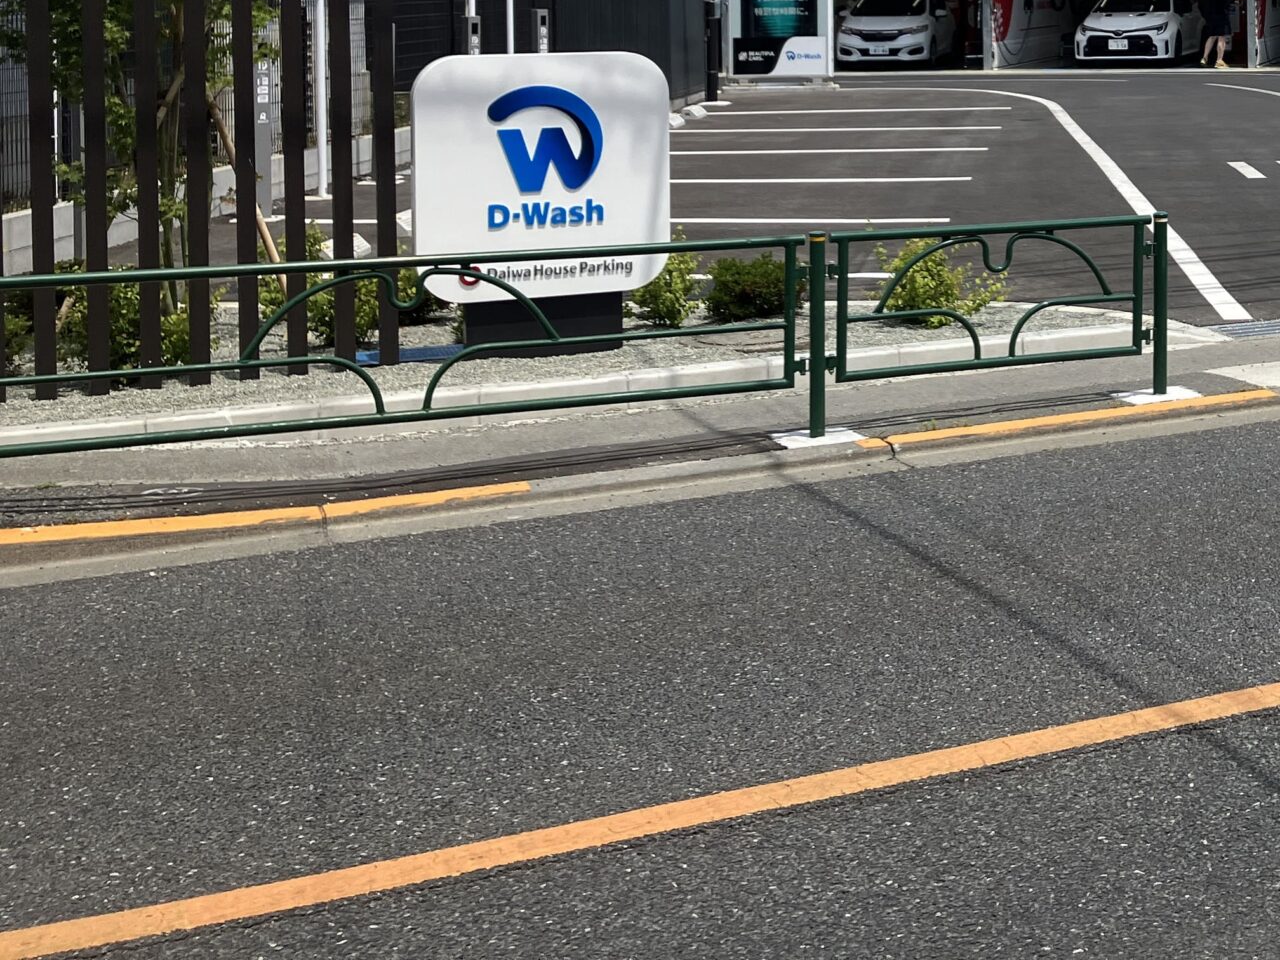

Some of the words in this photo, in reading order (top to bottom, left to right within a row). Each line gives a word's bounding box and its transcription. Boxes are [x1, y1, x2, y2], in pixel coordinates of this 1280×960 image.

[487, 198, 604, 230] D-Wash
[487, 266, 531, 280] Daiwa
[533, 263, 577, 278] House
[579, 258, 633, 275] Parking
